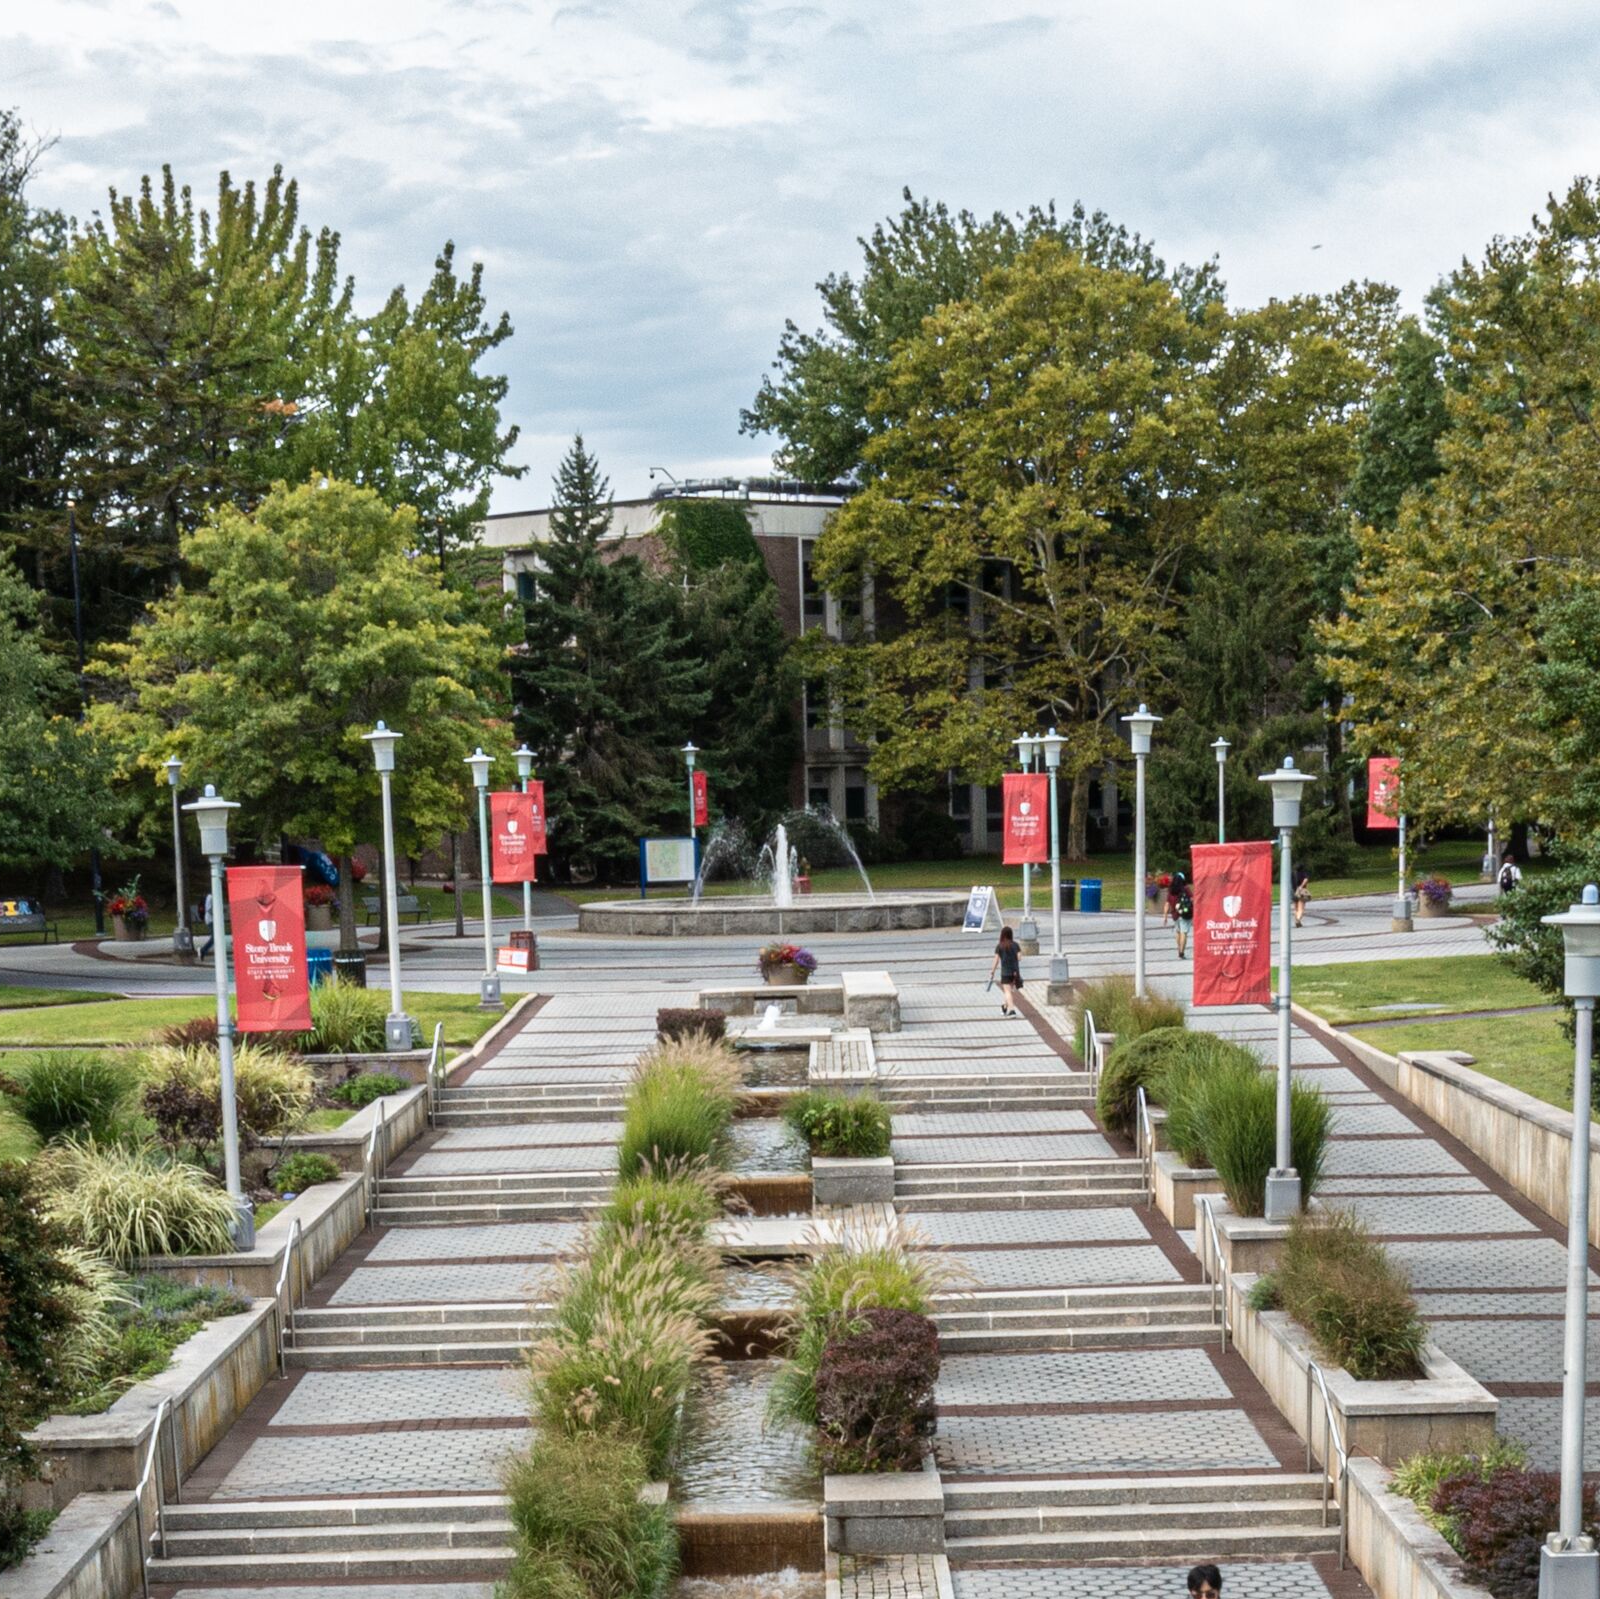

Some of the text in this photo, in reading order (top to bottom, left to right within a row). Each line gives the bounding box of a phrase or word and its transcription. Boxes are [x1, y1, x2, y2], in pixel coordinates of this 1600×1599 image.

[1206, 917, 1258, 931] Stony Brook
[1210, 929, 1254, 940] University
[245, 942, 293, 955] Stony Brook
[249, 954, 290, 965] University
